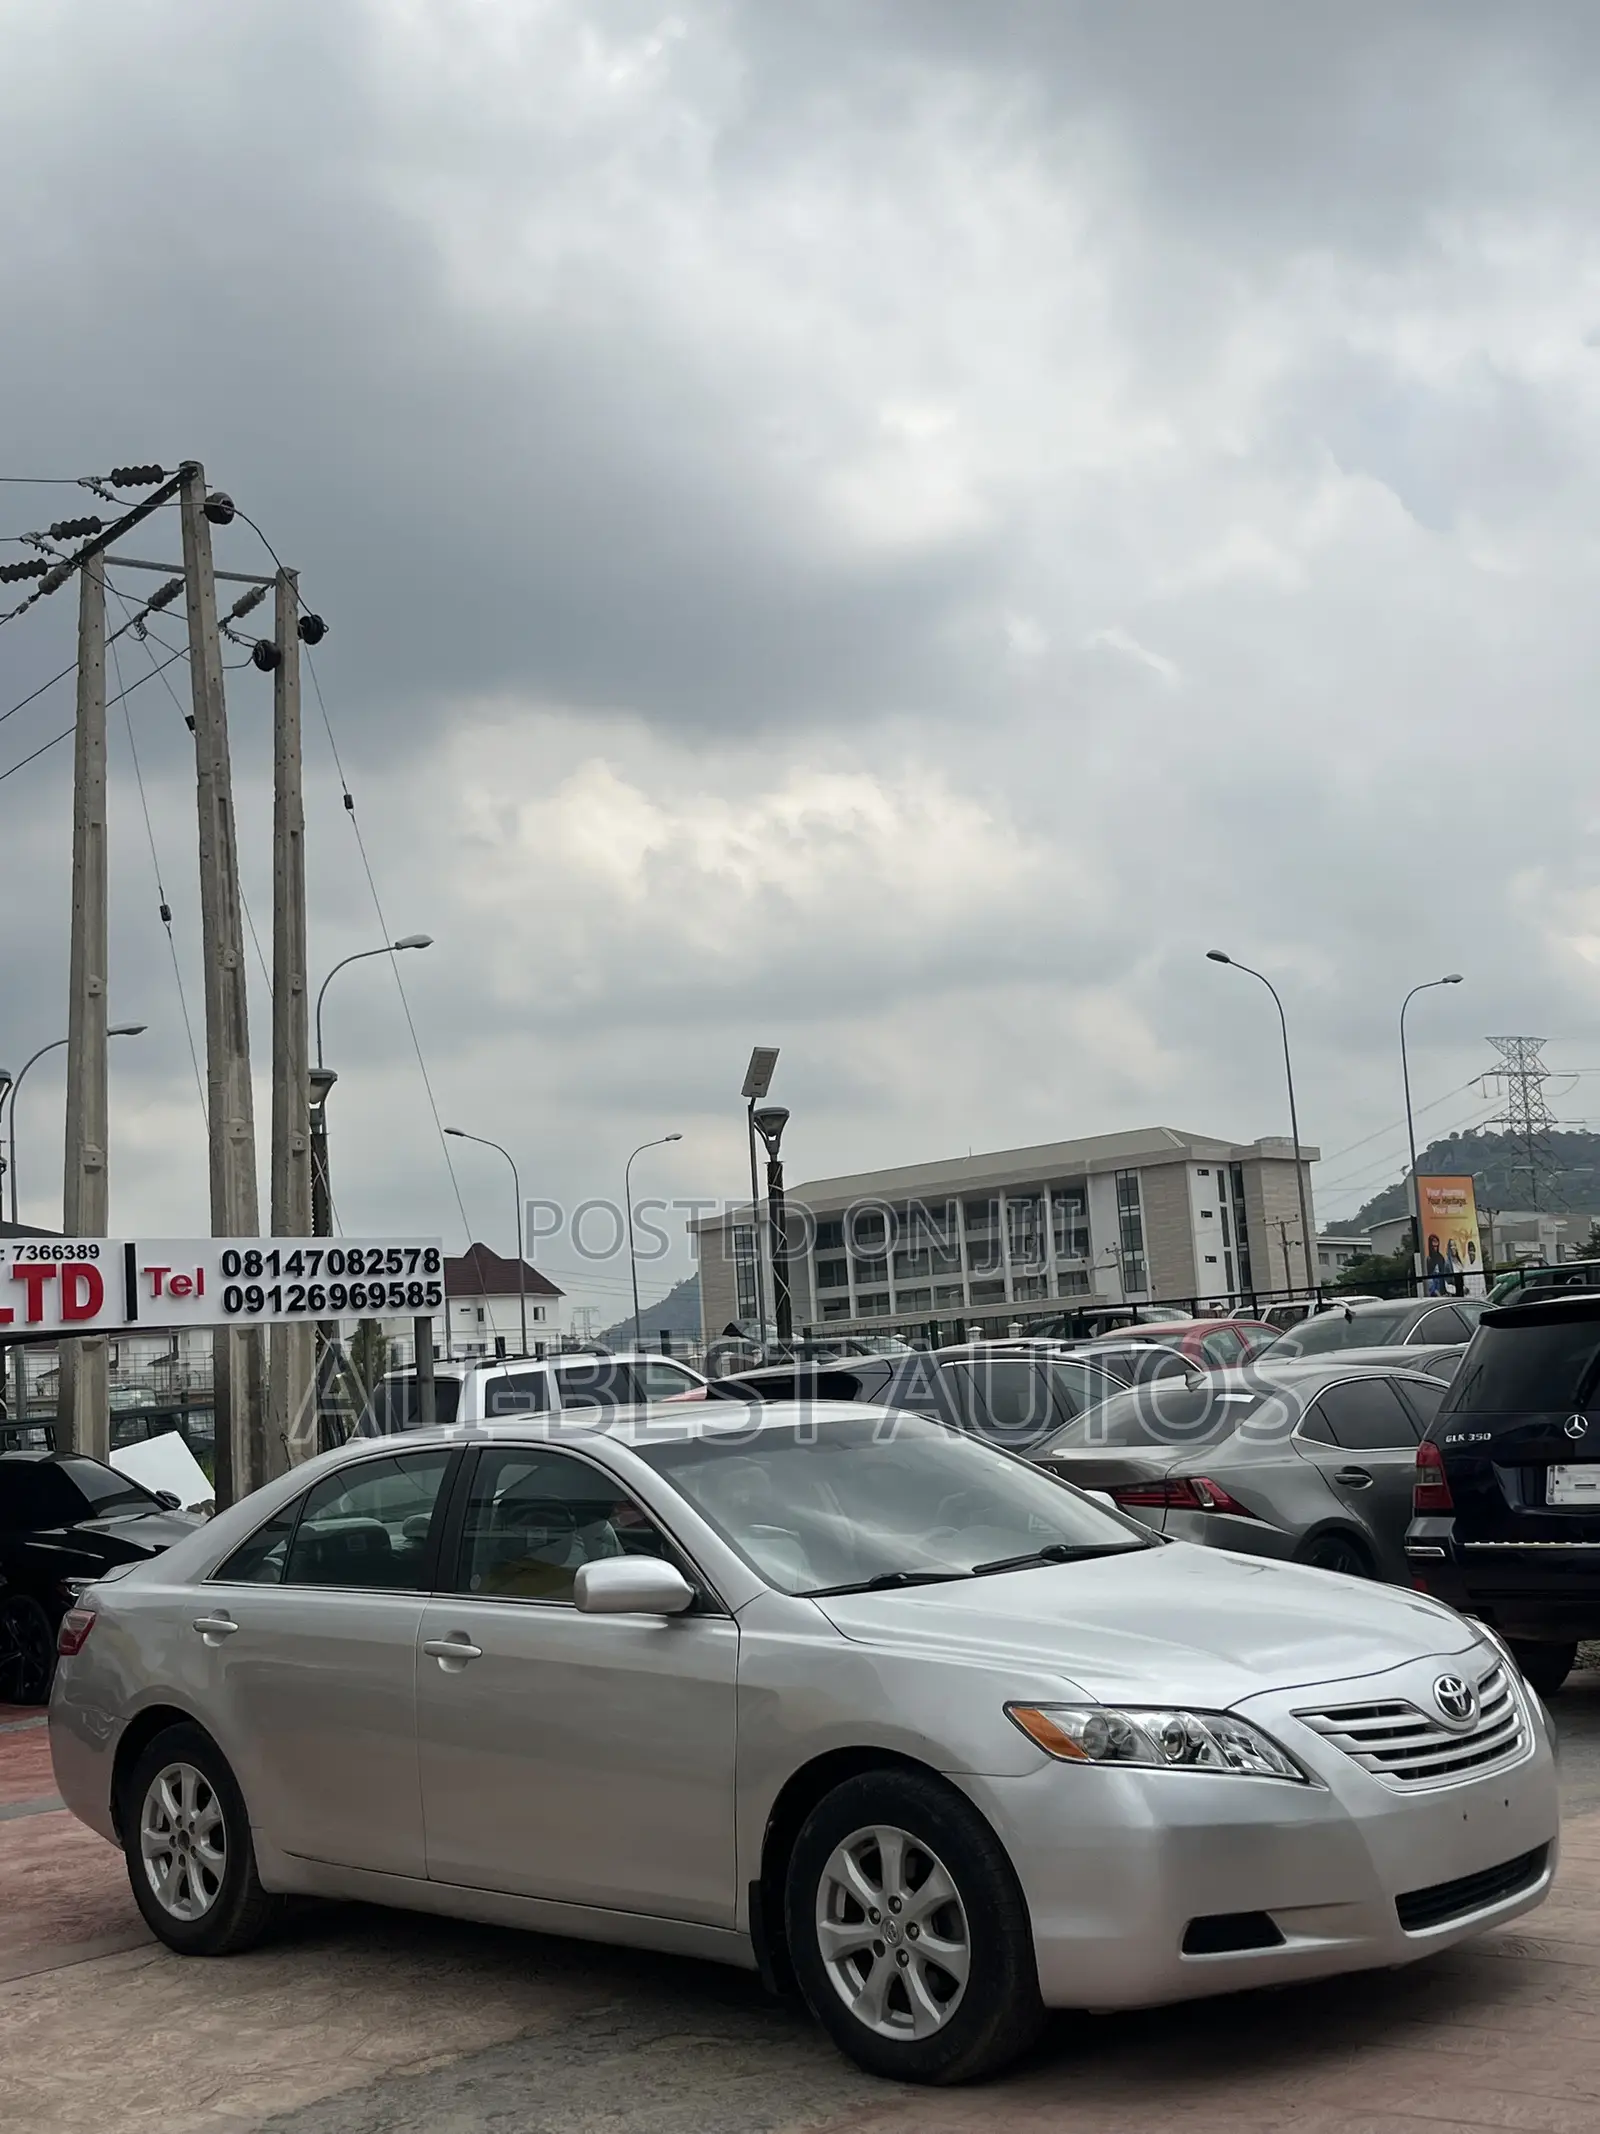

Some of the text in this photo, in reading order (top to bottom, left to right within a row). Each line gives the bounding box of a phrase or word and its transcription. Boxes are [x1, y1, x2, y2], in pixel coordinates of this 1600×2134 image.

[12, 1243, 100, 1261] 7366389
[221, 1247, 441, 1278] 08147082578
[143, 1267, 205, 1297] Tel
[223, 1281, 443, 1313] 09126969585
[1445, 1432, 1492, 1443] GLK 350
